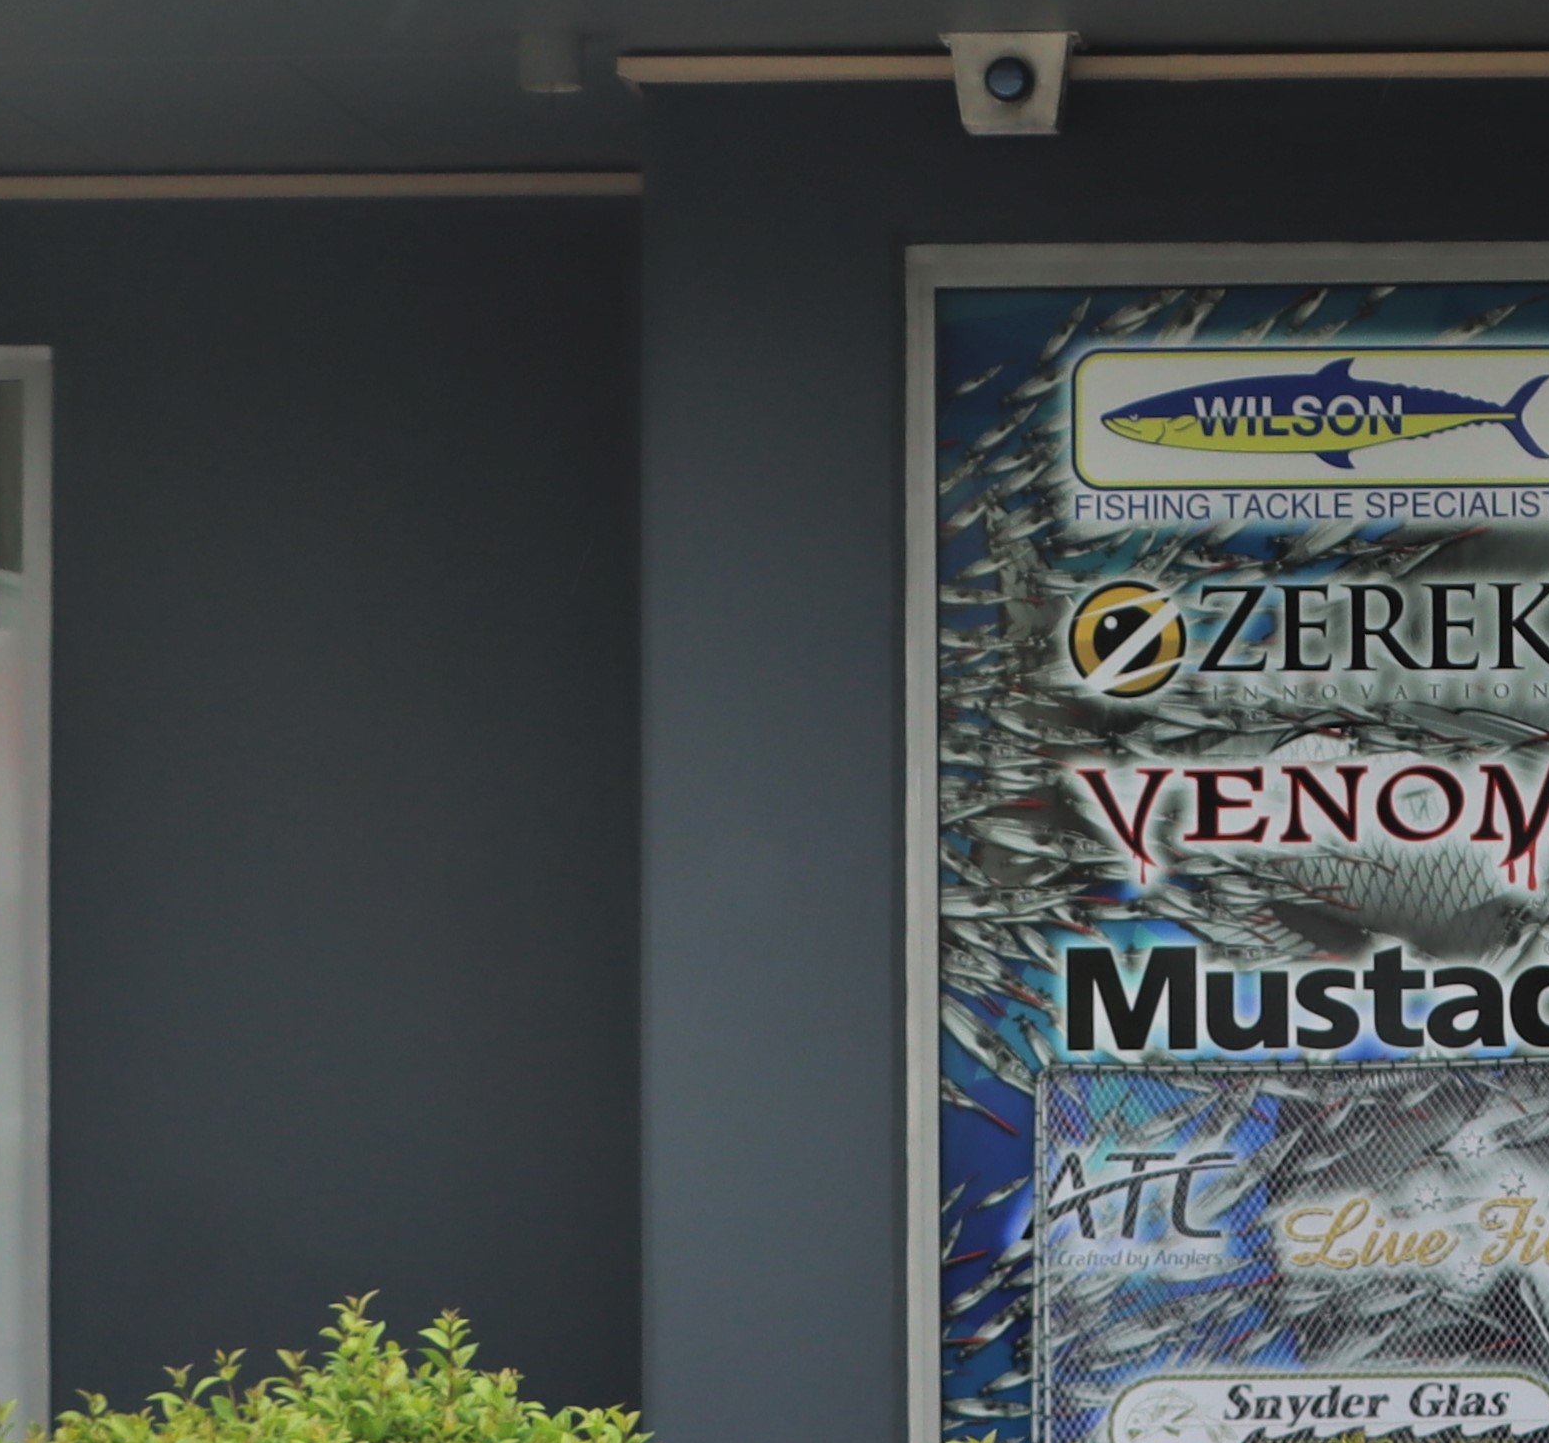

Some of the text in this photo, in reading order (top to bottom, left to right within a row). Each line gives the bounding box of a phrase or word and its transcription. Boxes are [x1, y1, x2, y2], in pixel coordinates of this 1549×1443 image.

[1193, 393, 1404, 438] WILSON
[1073, 492, 1211, 521] FISHING
[1221, 491, 1355, 521] TACKLE
[1211, 682, 1549, 703] INNOVATION
[1020, 1150, 1237, 1241] ATC
[1284, 1197, 1457, 1269] Live
[1126, 1246, 1149, 1271] by
[1154, 1246, 1224, 1271] Anglers
[1223, 1381, 1511, 1428] Snyder Glas
